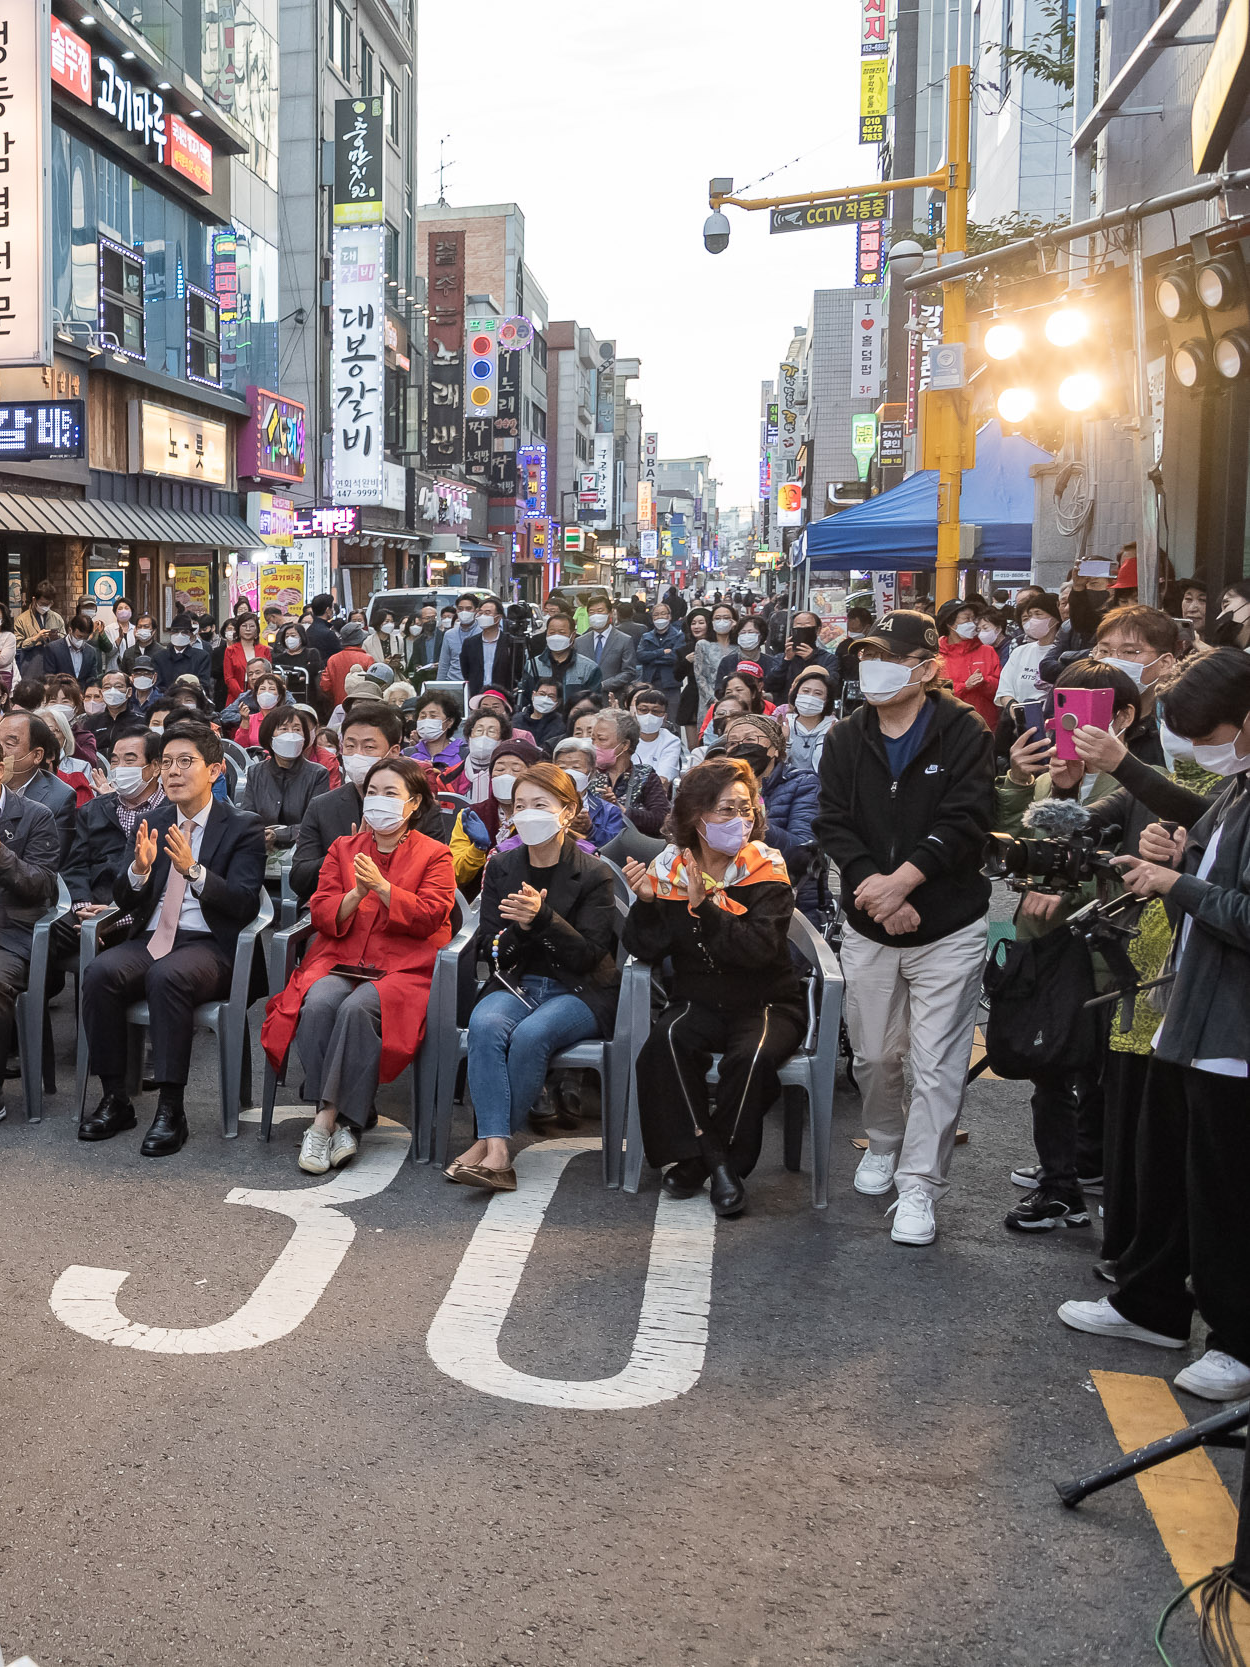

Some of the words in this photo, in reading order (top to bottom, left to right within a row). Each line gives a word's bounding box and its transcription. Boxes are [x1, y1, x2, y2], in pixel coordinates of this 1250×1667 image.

[98, 56, 168, 164] 고기마루
[862, 125, 883, 133] 6272
[806, 205, 843, 224] CCTV
[845, 199, 886, 220] 작동중
[469, 320, 495, 331] 프로
[861, 334, 873, 376] 홀덤펍
[337, 303, 379, 457] 대봉갈비
[859, 386, 872, 395] 3F
[475, 408, 487, 416] 2F
[882, 430, 901, 439] 24시
[883, 439, 901, 449] 무인
[336, 490, 378, 498] 447-9999
[293, 508, 356, 535] 노래방
[270, 573, 302, 583] 고기마루
[877, 614, 894, 632] LA
